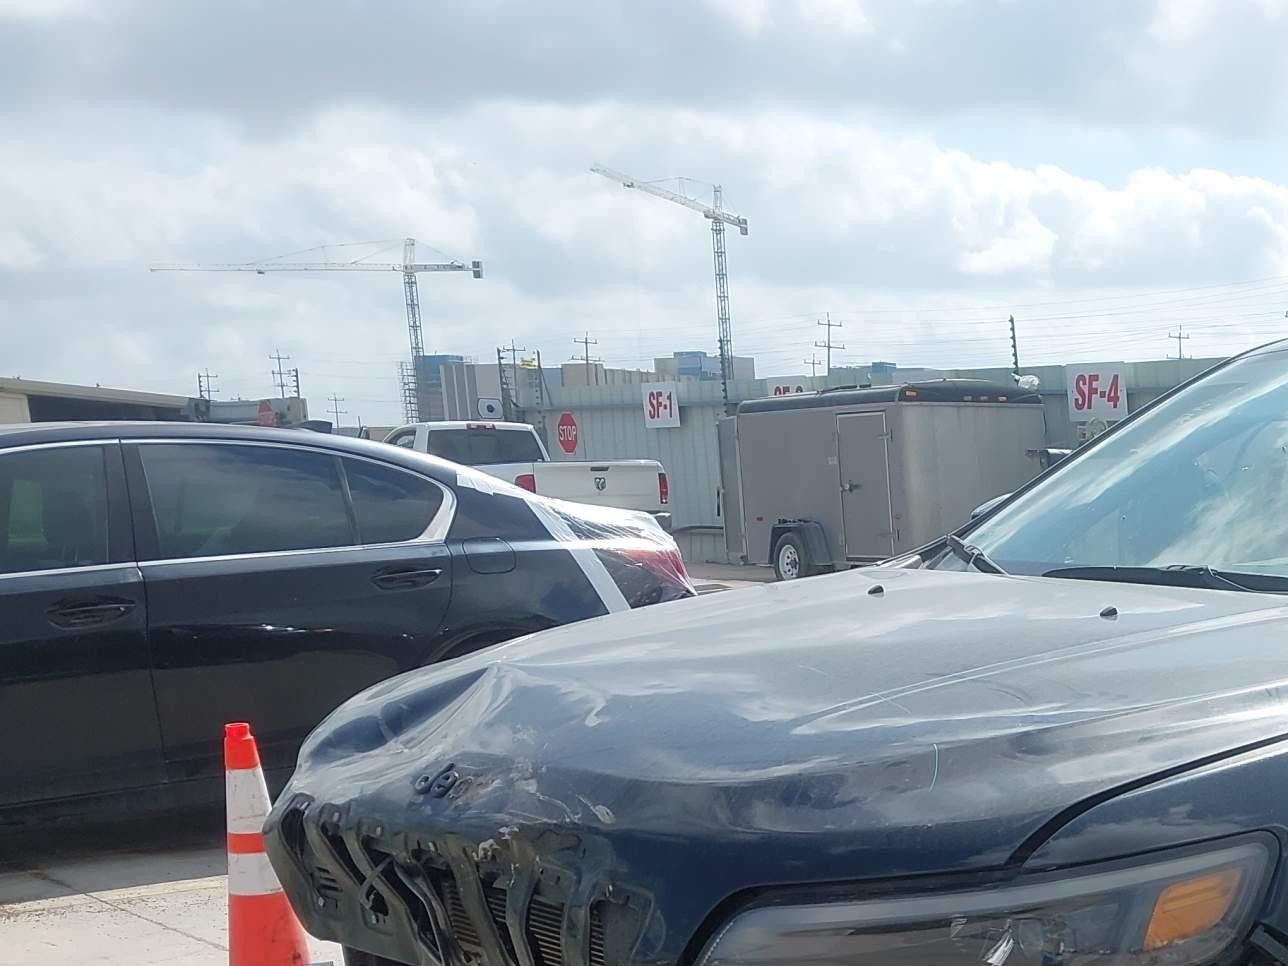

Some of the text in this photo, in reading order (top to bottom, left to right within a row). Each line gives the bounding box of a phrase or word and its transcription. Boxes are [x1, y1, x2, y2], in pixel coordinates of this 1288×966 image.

[648, 391, 673, 419] SF-1
[1074, 373, 1120, 411] SF-4
[558, 425, 577, 436] STOP
